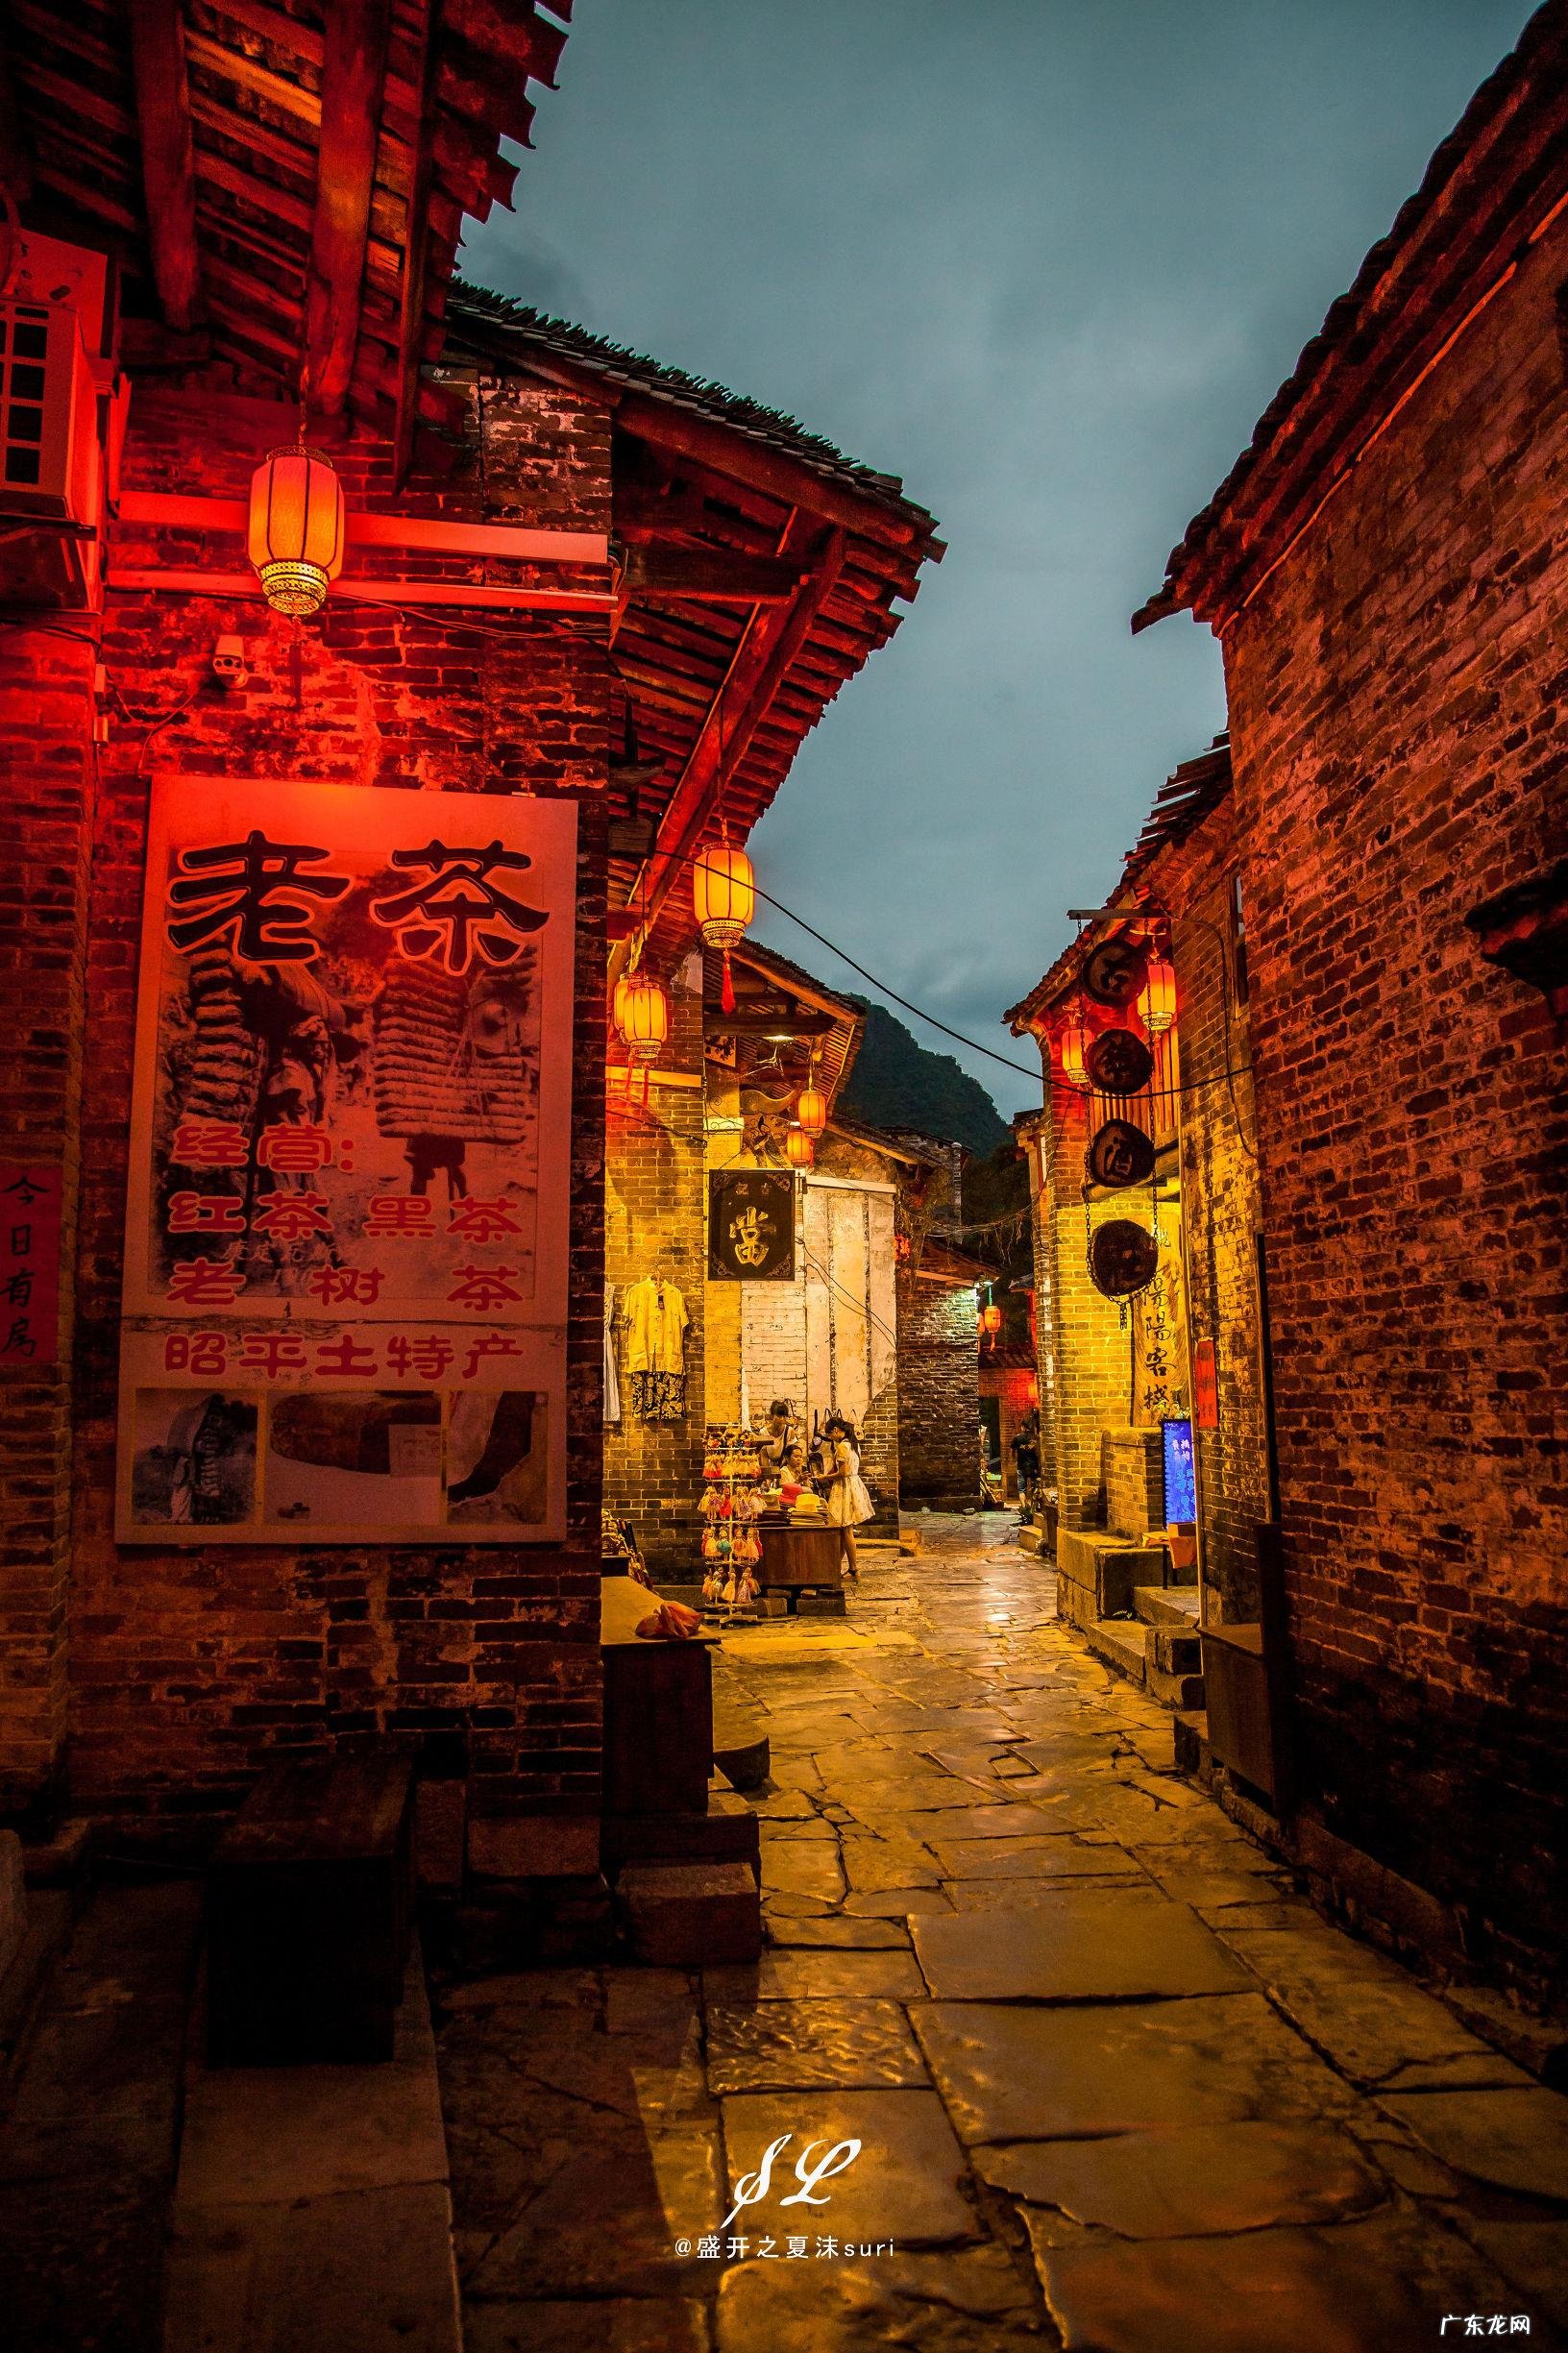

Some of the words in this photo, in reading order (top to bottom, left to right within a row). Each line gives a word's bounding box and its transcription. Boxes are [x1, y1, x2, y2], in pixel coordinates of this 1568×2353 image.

[168, 829, 550, 975] 老茶
[164, 1332, 524, 1381] 昭平土特产
